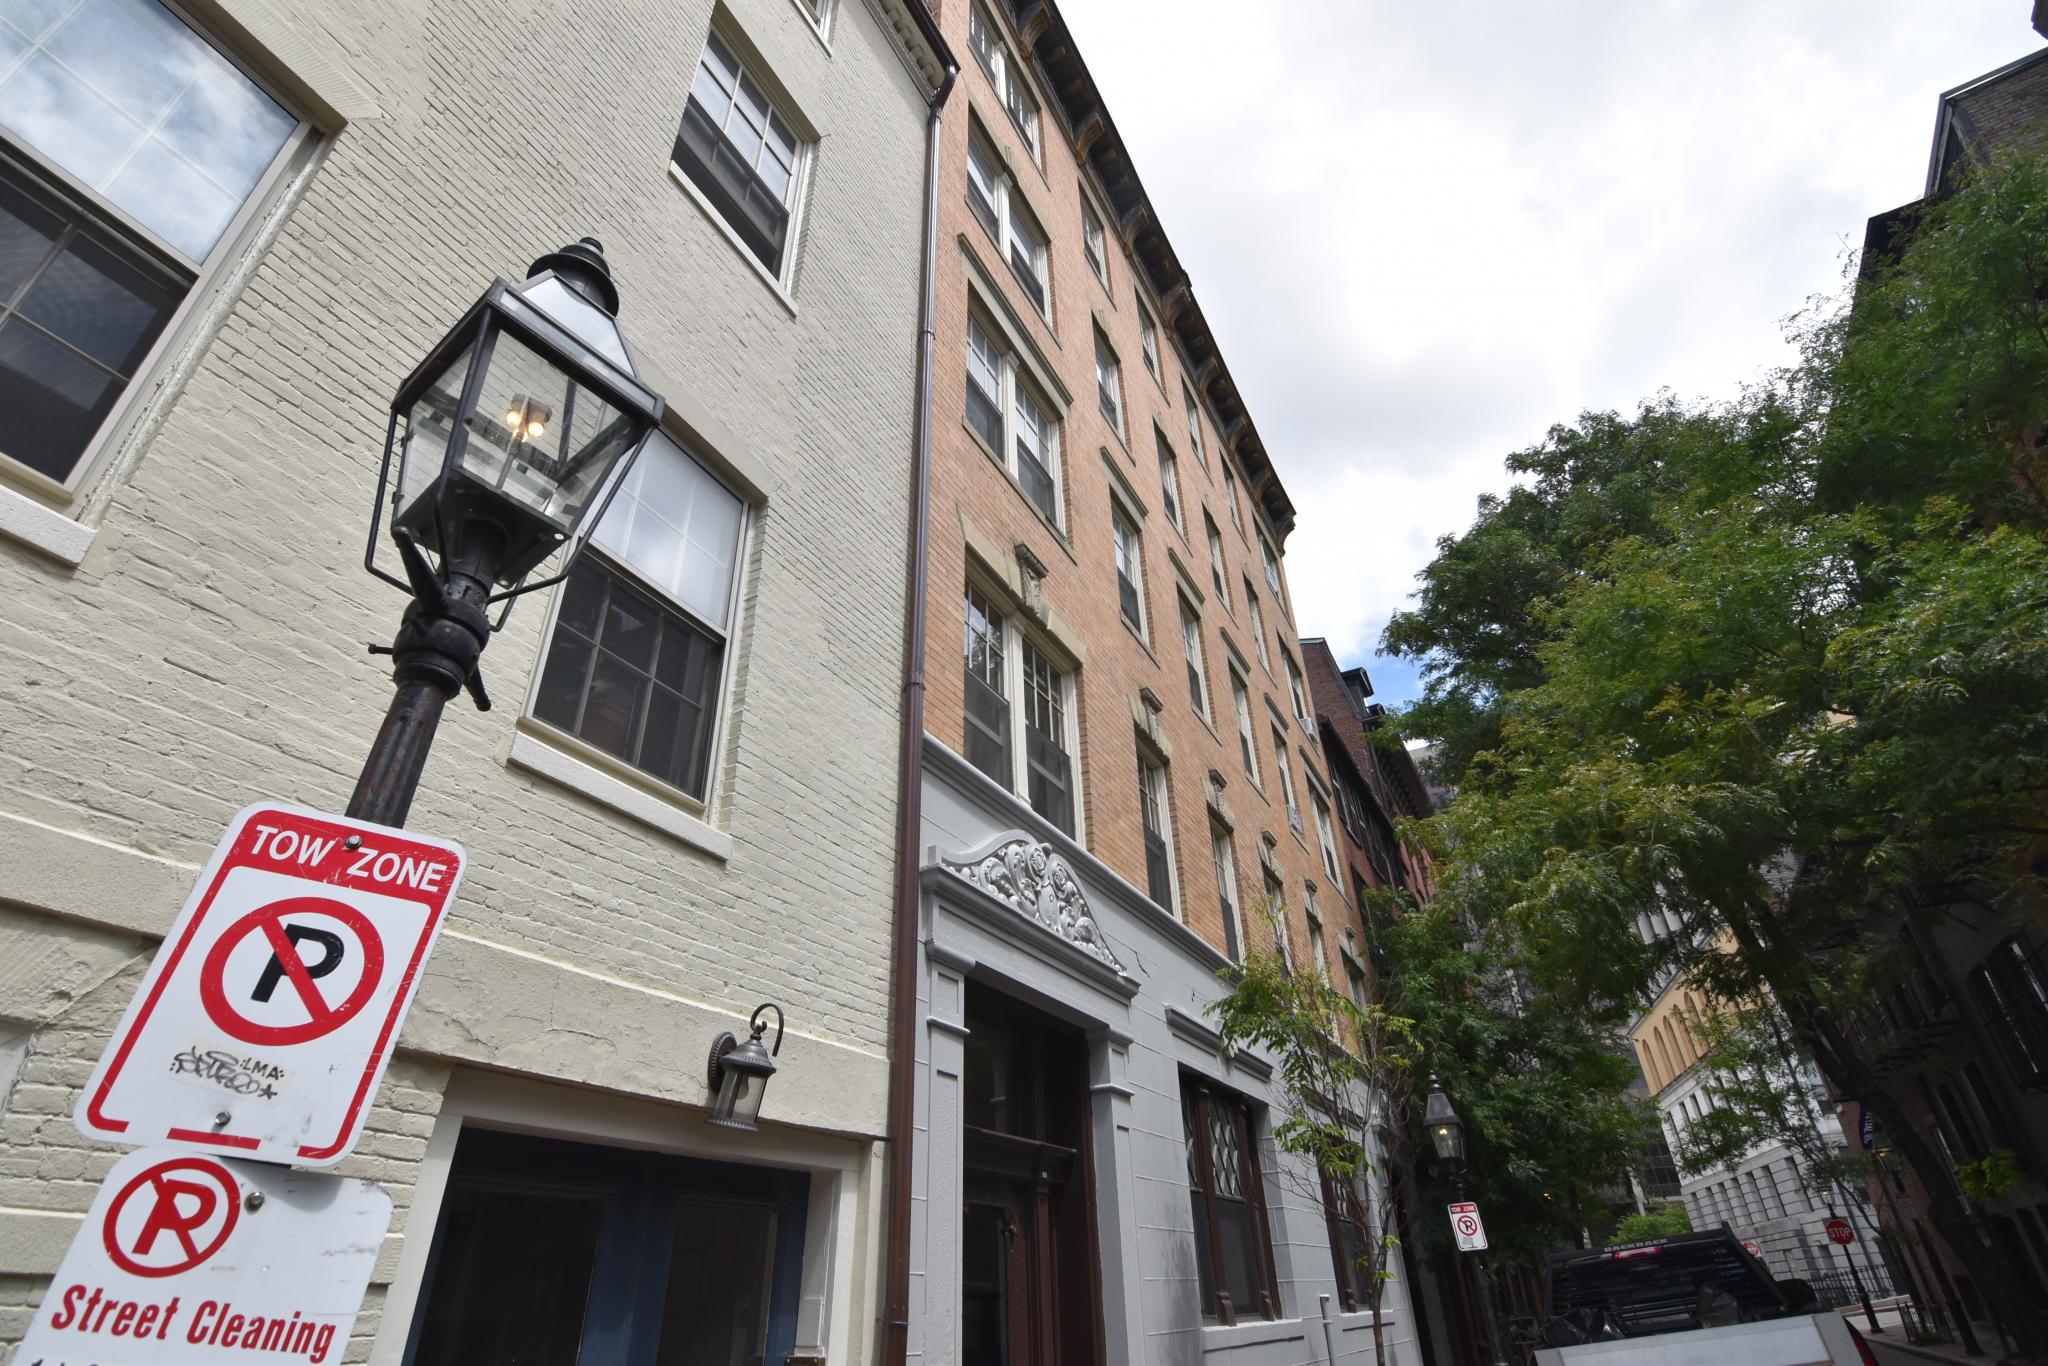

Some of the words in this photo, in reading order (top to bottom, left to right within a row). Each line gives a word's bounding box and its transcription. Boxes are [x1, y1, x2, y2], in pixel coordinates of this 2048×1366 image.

[251, 824, 335, 867] TOW
[346, 847, 448, 893] ZONE
[250, 923, 345, 1004] P
[1604, 1239, 1668, 1252] BACKRACK
[1829, 1226, 1851, 1238] STOP
[51, 1284, 180, 1340] Street
[186, 1299, 337, 1364] Cleaning
